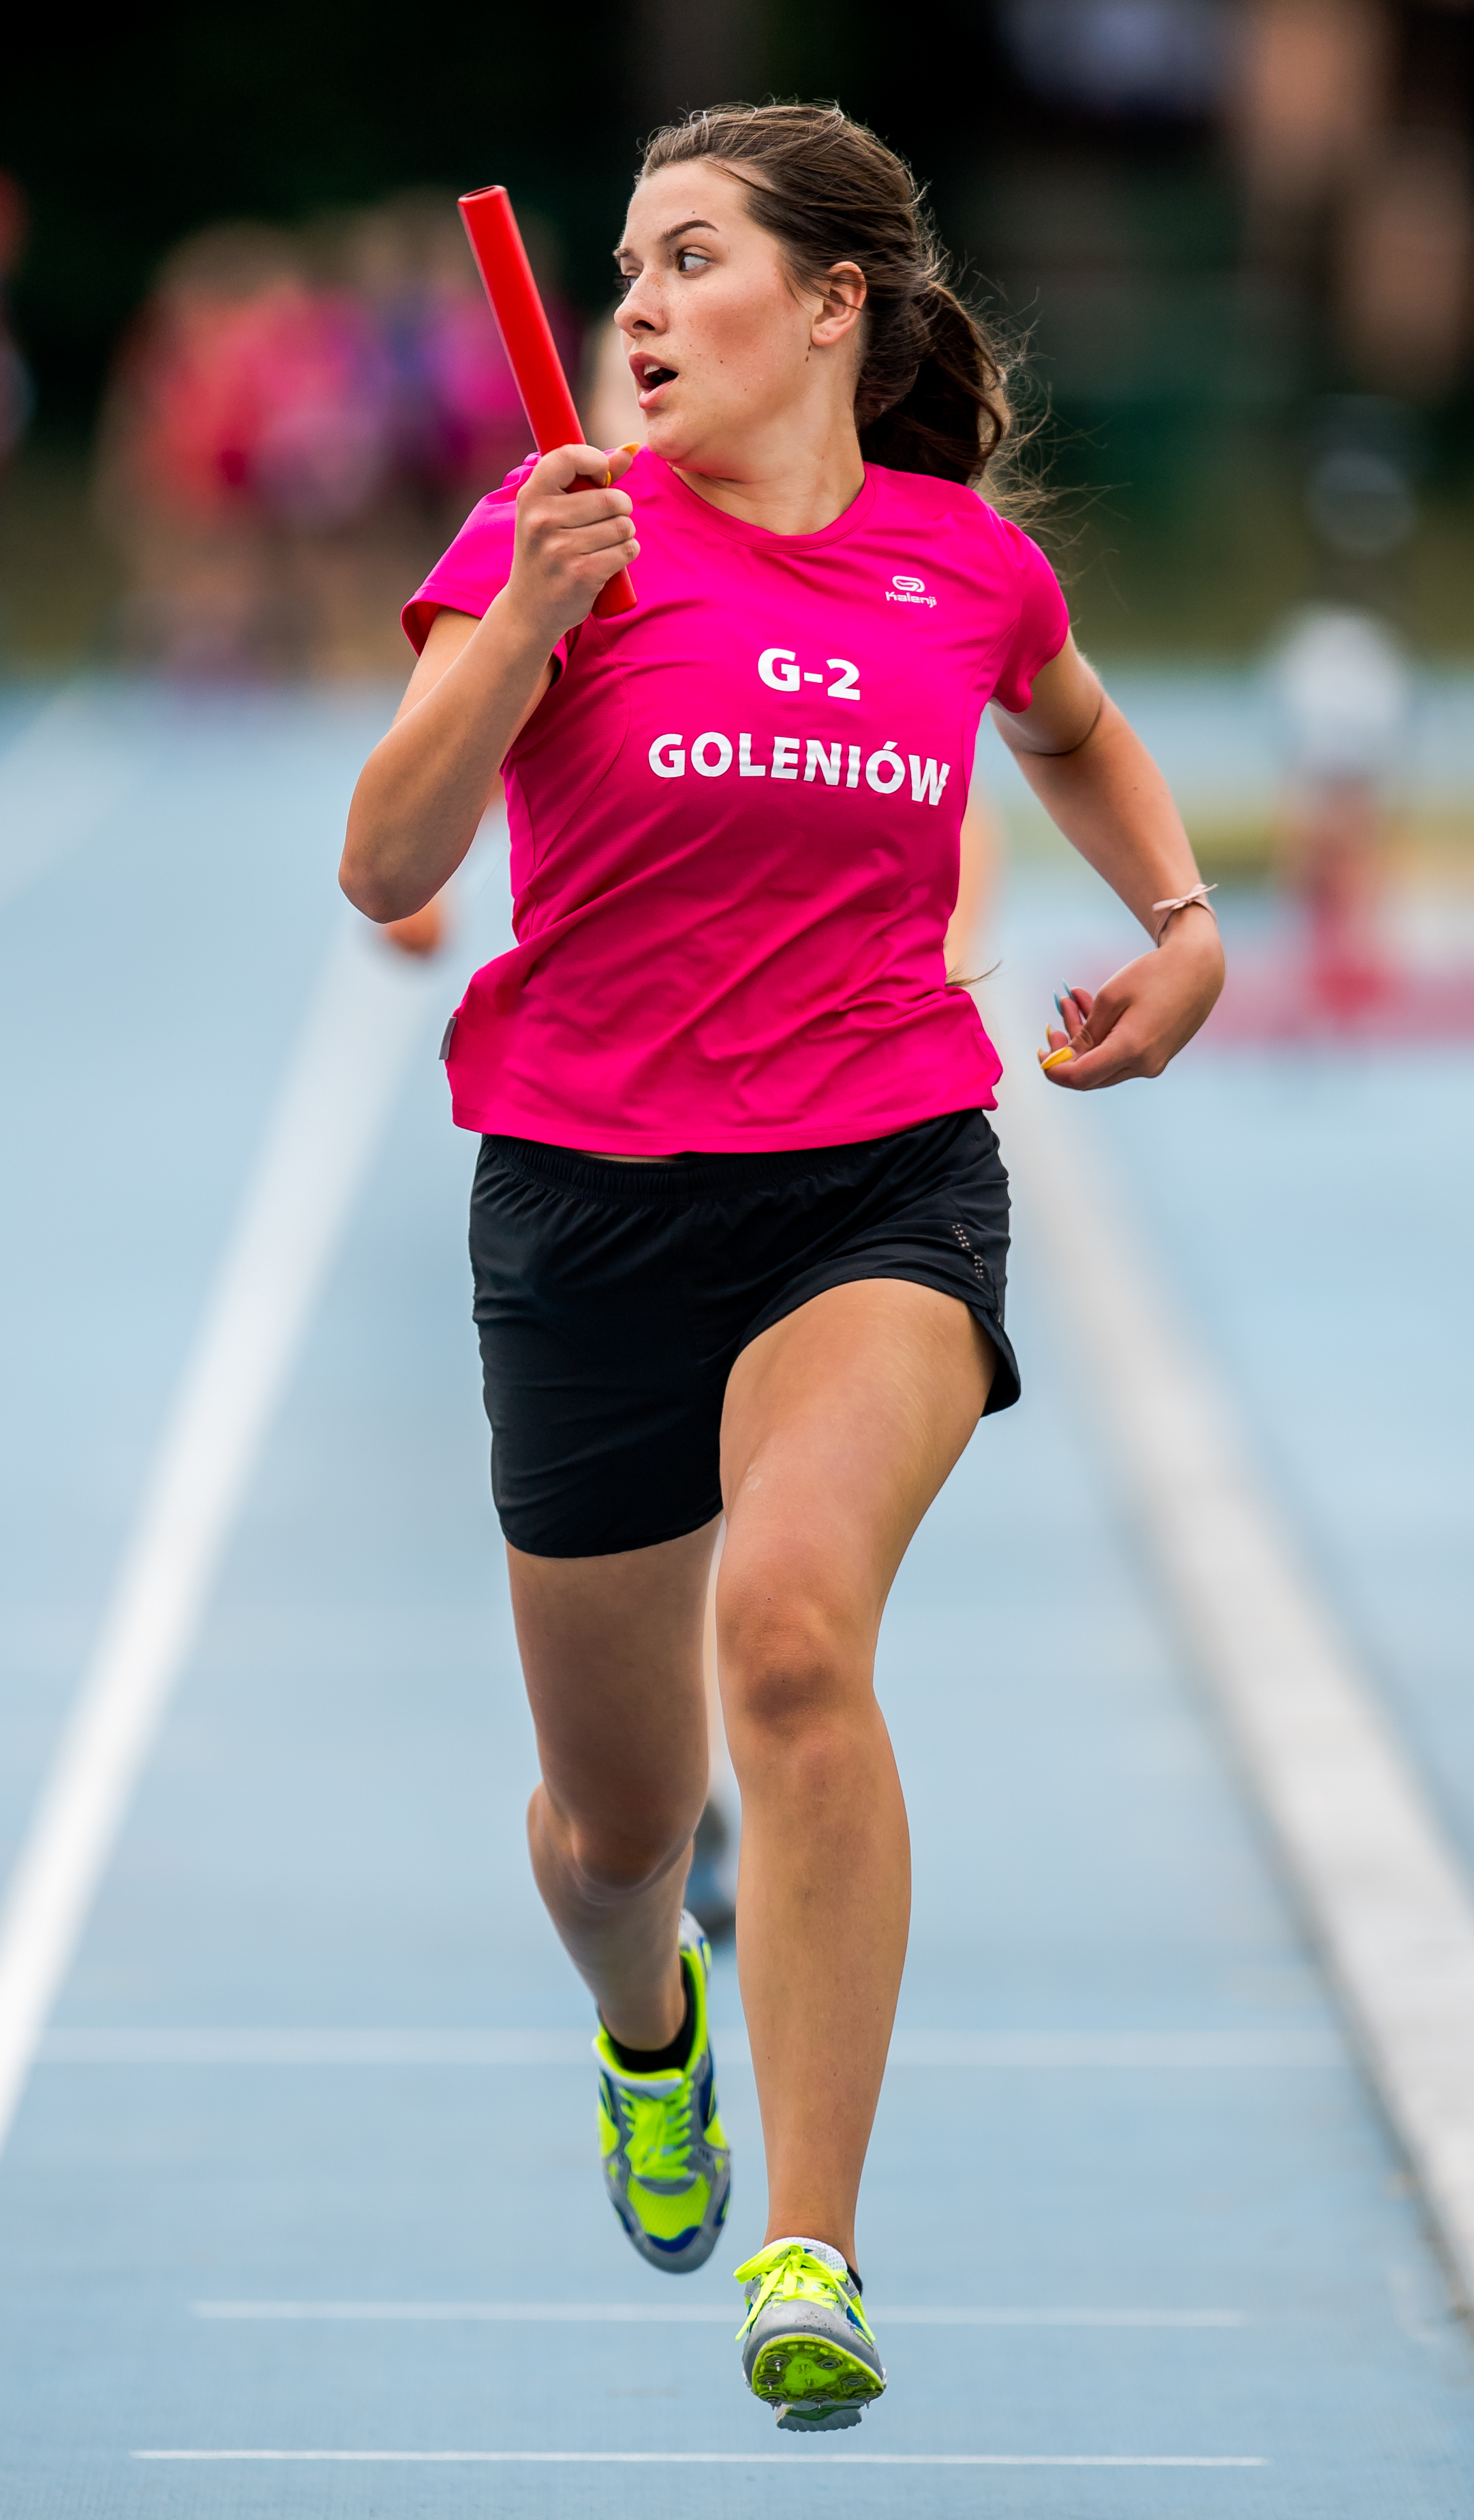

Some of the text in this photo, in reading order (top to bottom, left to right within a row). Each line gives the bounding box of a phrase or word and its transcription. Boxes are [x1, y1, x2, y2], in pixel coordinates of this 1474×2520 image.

[885, 591, 938, 608] Kalenji
[757, 648, 861, 701] G-2
[648, 731, 951, 806] GOLENIÓW
